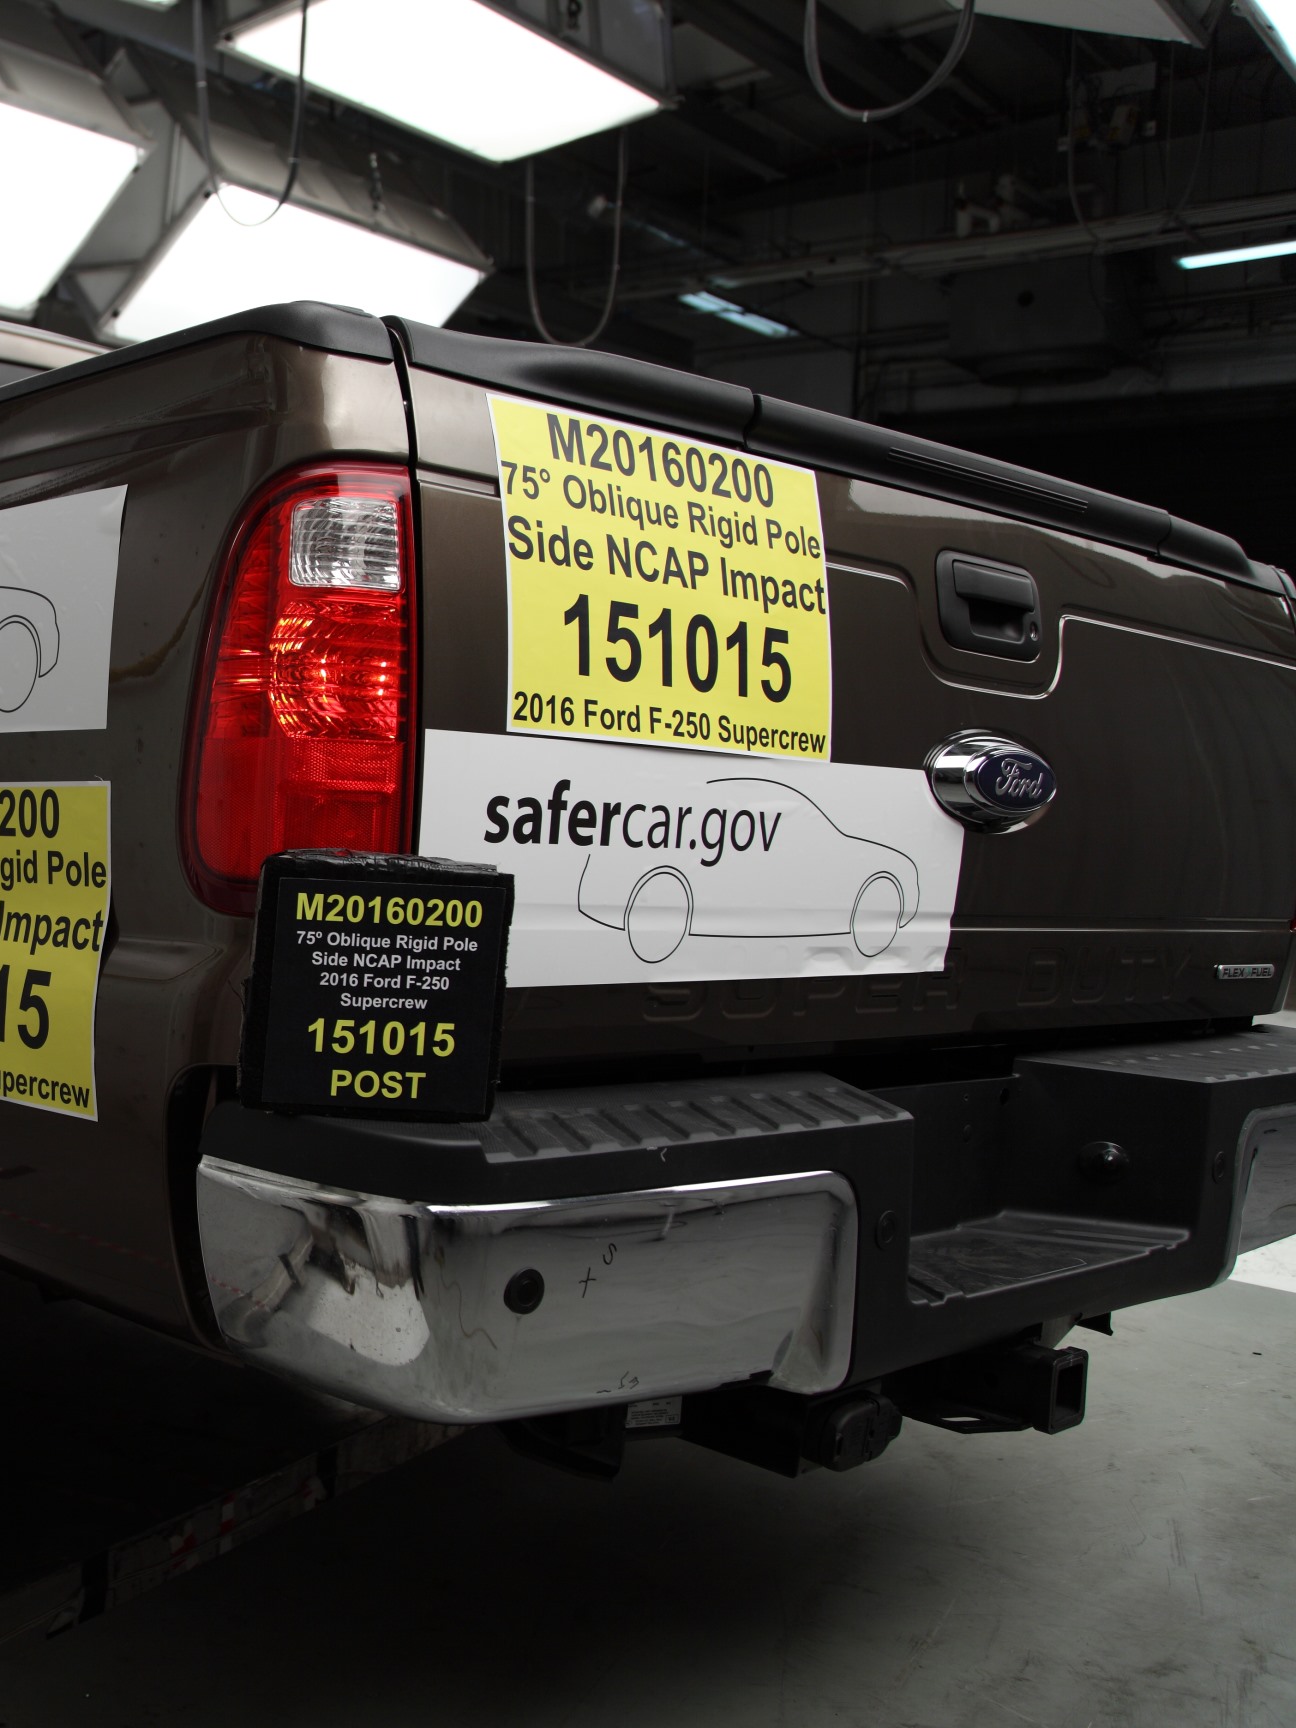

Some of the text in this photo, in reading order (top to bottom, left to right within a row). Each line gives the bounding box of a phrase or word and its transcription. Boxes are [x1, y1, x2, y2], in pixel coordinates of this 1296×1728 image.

[547, 413, 773, 507] M20160200
[563, 475, 679, 531] Oblique
[687, 501, 758, 548] Rigid
[766, 519, 821, 559] Pole
[507, 515, 826, 615] Side NCAP Impact
[564, 594, 792, 703] 151015
[513, 691, 826, 754] 2016 Ford F-250 Supercrew
[994, 757, 1045, 799] Ford
[484, 779, 782, 867] safercar.gov
[48, 851, 107, 888] Pole
[296, 892, 483, 928] M20160200
[327, 931, 391, 952] Oblique
[396, 935, 438, 953] Rigid
[443, 936, 478, 952] Pole
[311, 951, 461, 974] Side NCAP Impact
[319, 972, 450, 991] 2016 Ford F-250
[1222, 967, 1272, 978] FLEX FUEL
[340, 992, 428, 1010] Supercrew
[307, 1017, 456, 1058] 151015
[330, 1069, 427, 1100] POST
